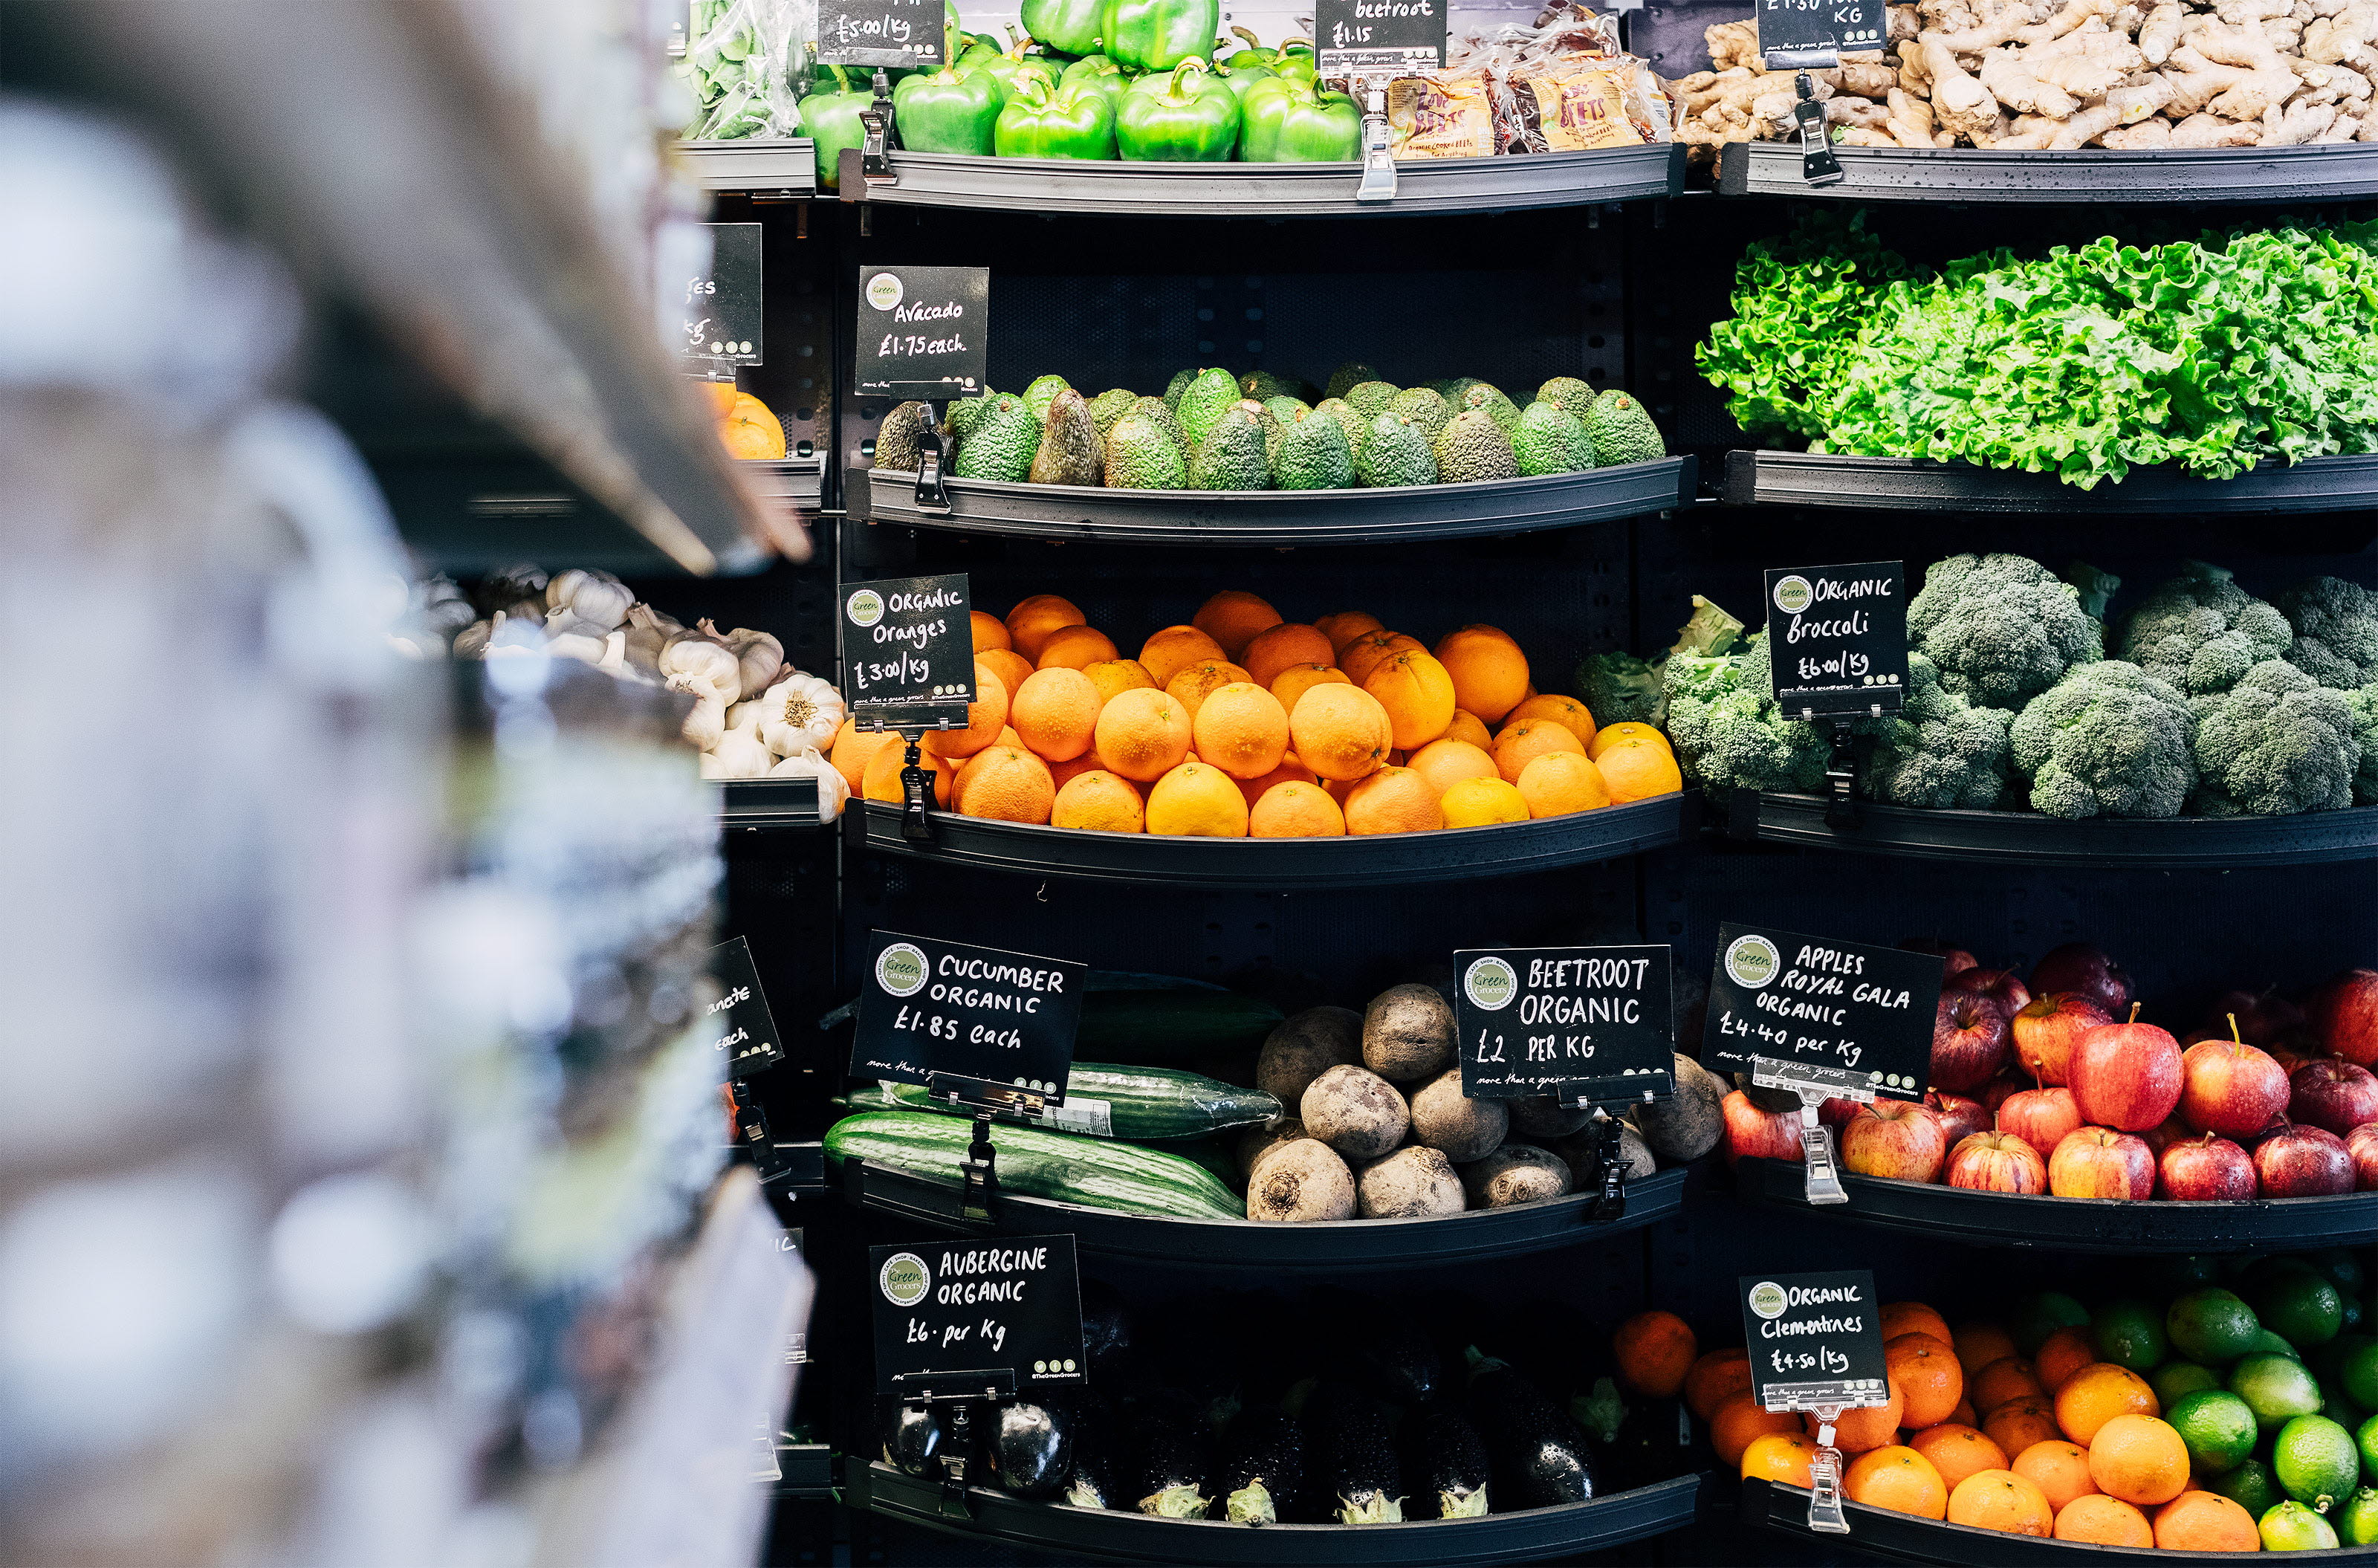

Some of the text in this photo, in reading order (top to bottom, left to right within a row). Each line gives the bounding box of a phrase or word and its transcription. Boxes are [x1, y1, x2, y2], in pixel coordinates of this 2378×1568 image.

[1834, 6, 1862, 23] KG
[1332, 21, 1373, 48] £1.15
[1561, 97, 1606, 128] BEETS
[894, 300, 963, 323] Avacado
[878, 333, 926, 357] £1.75
[889, 589, 963, 612] ORGANIC
[1781, 589, 1807, 597] Green
[1815, 577, 1892, 602] ORGANIC
[854, 602, 878, 610] Green
[873, 619, 947, 649] Oranges
[1786, 610, 1869, 644] Broccoli
[911, 948, 926, 964] BAKERY
[1737, 951, 1770, 965] Green
[1762, 941, 1776, 956] BAKERY
[1795, 945, 1865, 975] APPLES
[885, 969, 917, 982] Grocers
[887, 959, 920, 973] Green
[939, 954, 1063, 993] CUCUMBER
[1496, 960, 1512, 973] BAKERY
[1529, 959, 1649, 990] BEETROOT
[1734, 962, 1768, 974] Grocers
[1474, 975, 1509, 986] Green
[1474, 985, 1507, 994] Grocers
[1781, 969, 1910, 1009] ROYAL GALA
[930, 984, 1040, 1014] ORGANIC
[1520, 994, 1639, 1025] ORGANIC
[1756, 991, 1846, 1026] ORGANIC
[894, 1005, 958, 1040] £1.85
[1720, 1010, 1787, 1045] £4.40
[1795, 1037, 1828, 1053] per
[1477, 1028, 1595, 1063] £2 PER KG
[866, 1060, 892, 1069] more
[895, 1060, 915, 1074] than
[1717, 1051, 1743, 1061] more
[1746, 1052, 1767, 1066] than
[1778, 1062, 1811, 1074] green
[1812, 1068, 1846, 1079] grocers
[1505, 1073, 1525, 1084] than
[910, 1257, 925, 1269] BAKERY
[939, 1247, 1046, 1277] AUBERGINE
[890, 1271, 921, 1282] Green
[890, 1282, 921, 1290] Grocers
[938, 1280, 1026, 1306] ORGANIC
[1756, 1295, 1781, 1303] Green
[942, 1325, 970, 1349] per
[1760, 1315, 1863, 1338] Clementines
